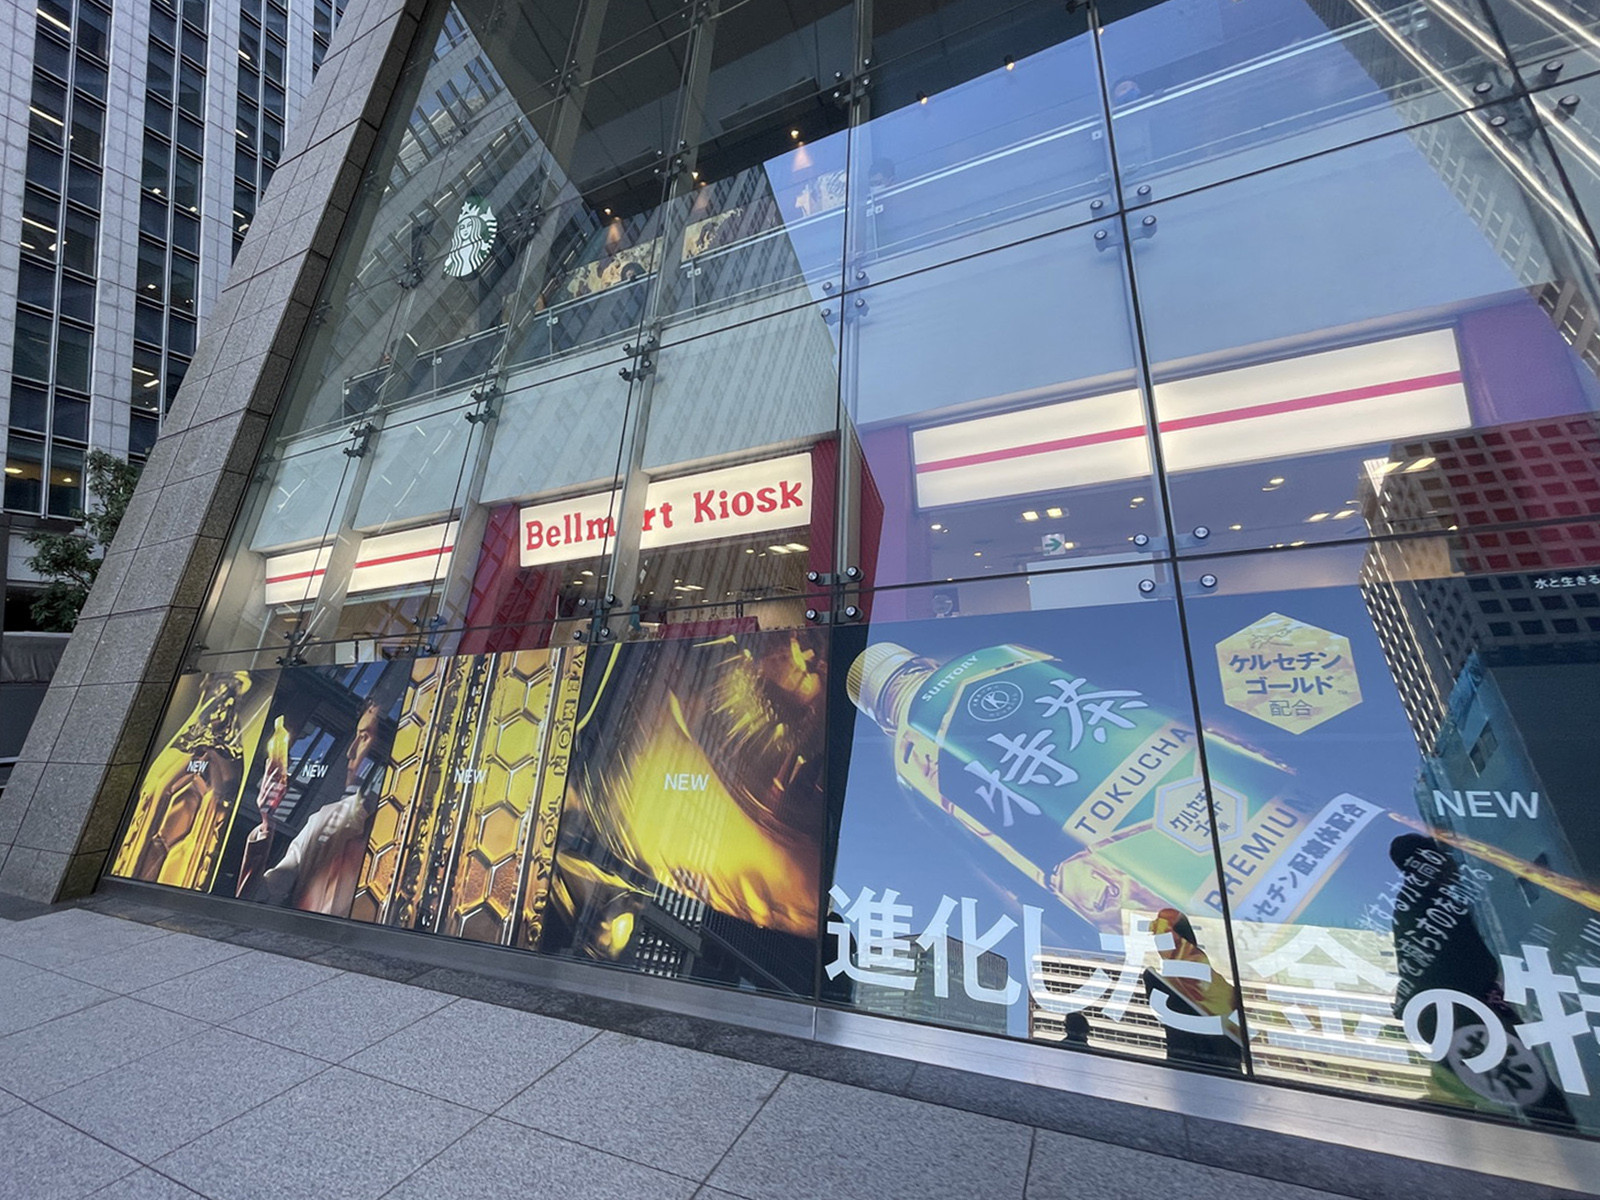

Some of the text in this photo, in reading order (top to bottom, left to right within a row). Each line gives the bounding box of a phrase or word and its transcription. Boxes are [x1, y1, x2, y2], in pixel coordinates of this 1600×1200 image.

[526, 481, 804, 551] Bellmrt Kiosk
[1229, 652, 1342, 673] ケルセチン
[921, 655, 978, 702] SUNTORY
[1245, 676, 1334, 695] ゴールド
[1269, 699, 1313, 717] 配合
[964, 677, 1148, 827] 特茶
[187, 760, 209, 773] NEW
[302, 764, 328, 778] NEW
[453, 769, 487, 783] NEW
[664, 773, 709, 791] NEW
[1074, 726, 1194, 838] TOKUCHA
[1432, 790, 1539, 818] NEW
